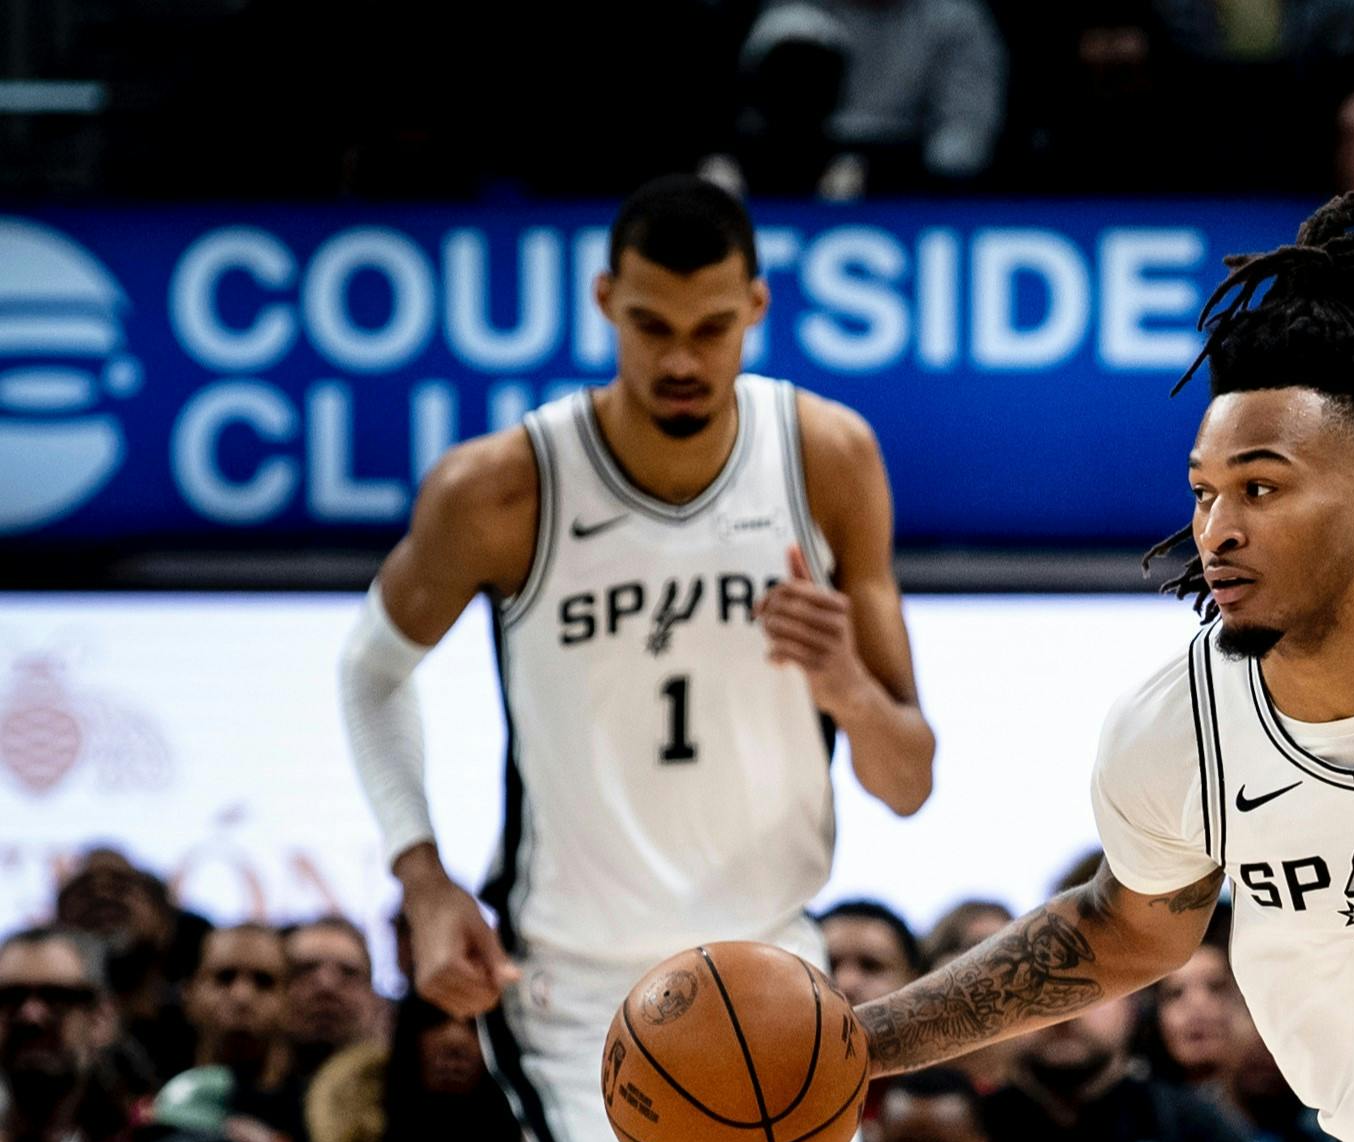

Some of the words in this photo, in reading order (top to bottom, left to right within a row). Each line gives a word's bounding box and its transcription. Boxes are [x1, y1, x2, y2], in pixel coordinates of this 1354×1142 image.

[170, 379, 610, 524] CL
[559, 571, 784, 655] SPUR
[658, 674, 699, 765] 1
